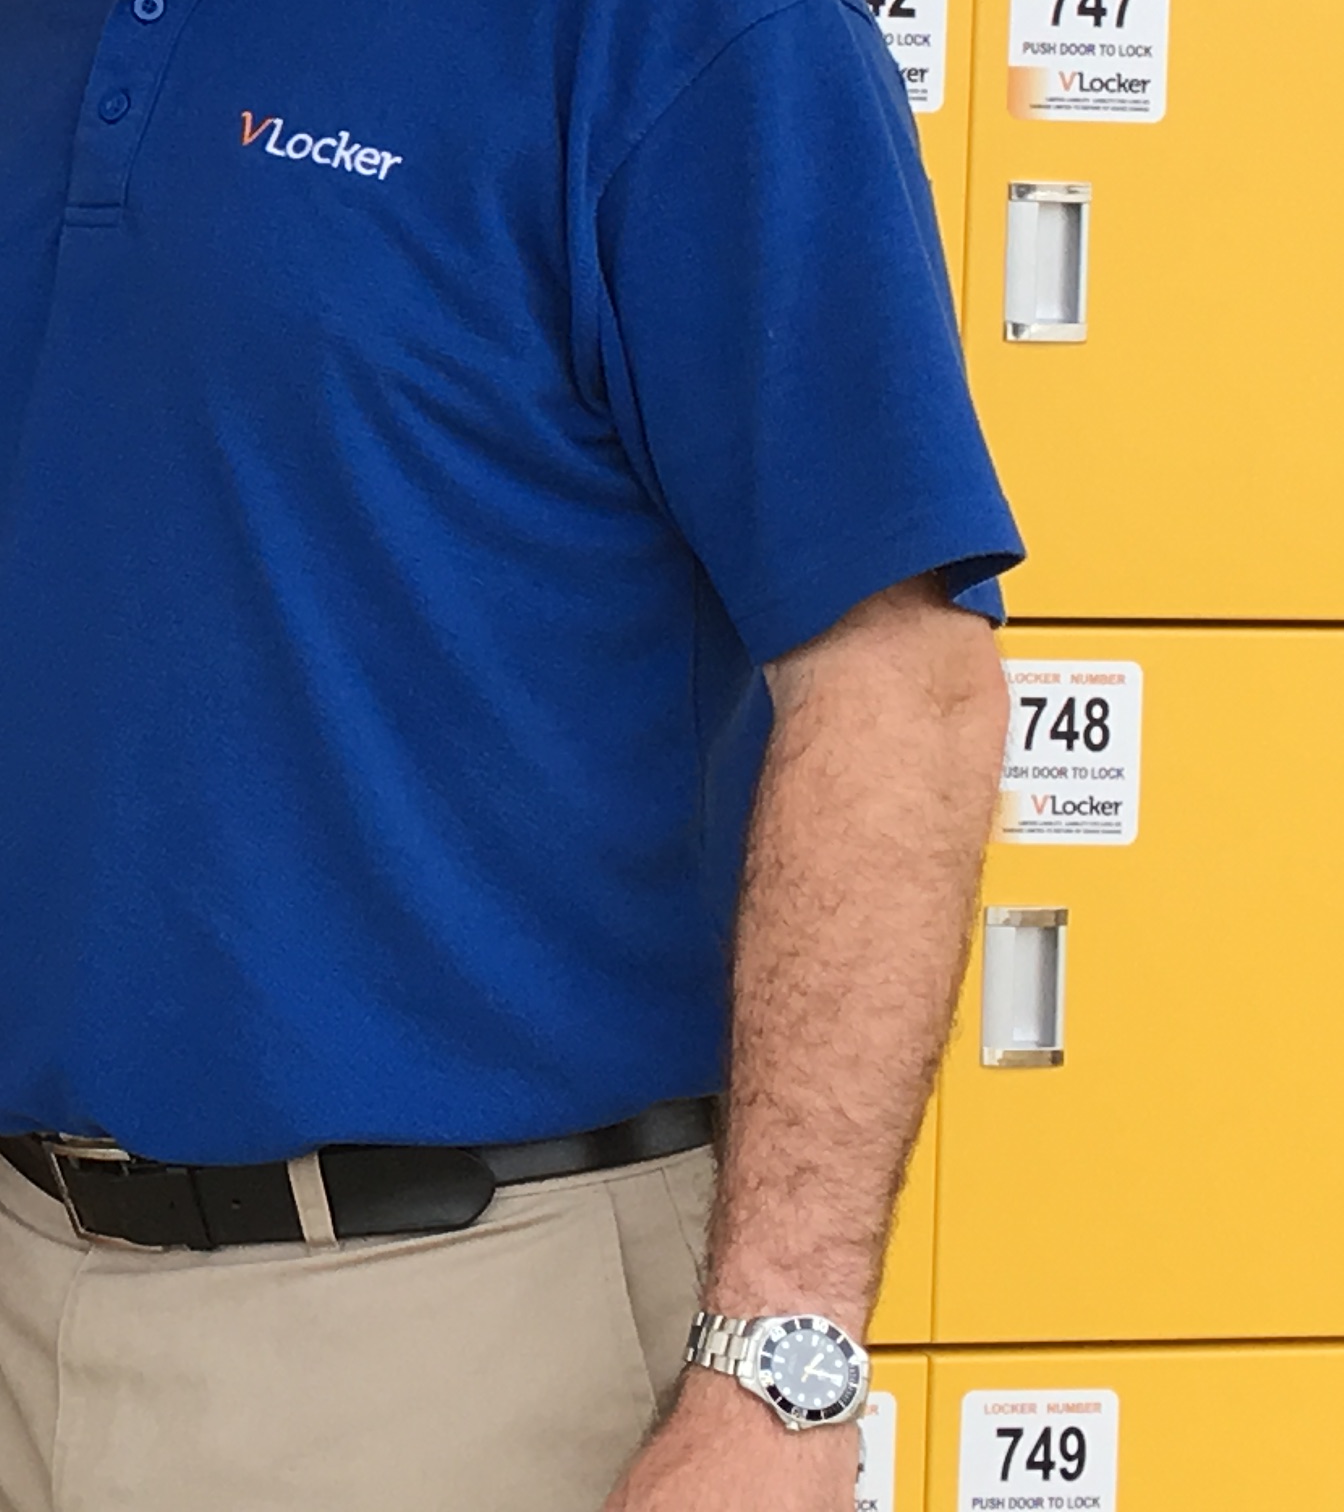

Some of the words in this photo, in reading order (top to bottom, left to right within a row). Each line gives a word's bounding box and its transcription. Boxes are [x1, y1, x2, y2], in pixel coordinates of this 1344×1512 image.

[898, 34, 931, 47] LOCK
[1022, 42, 1056, 55] PUSH
[1060, 43, 1096, 56] DOOR
[1099, 44, 1116, 57] TO
[1118, 45, 1152, 58] LOCK
[1059, 71, 1151, 94] VLocker
[241, 110, 403, 180] VLocker
[1008, 673, 1061, 684] LOCKER
[1070, 673, 1126, 685] NUMBER
[1020, 696, 1110, 752] 748
[1004, 767, 1028, 779] USH
[1032, 767, 1068, 779] DOOR
[1071, 767, 1088, 779] TO
[1091, 767, 1124, 780] LOCK
[1031, 794, 1123, 816] VLocker
[983, 1402, 1038, 1415] LOCKER
[1047, 1402, 1102, 1414] NUMBER
[996, 1426, 1087, 1482] 749
[972, 1497, 1006, 1511] PUSH
[1008, 1497, 1044, 1511] DOOR
[1047, 1497, 1064, 1510] TO
[1067, 1496, 1100, 1509] LOCK
